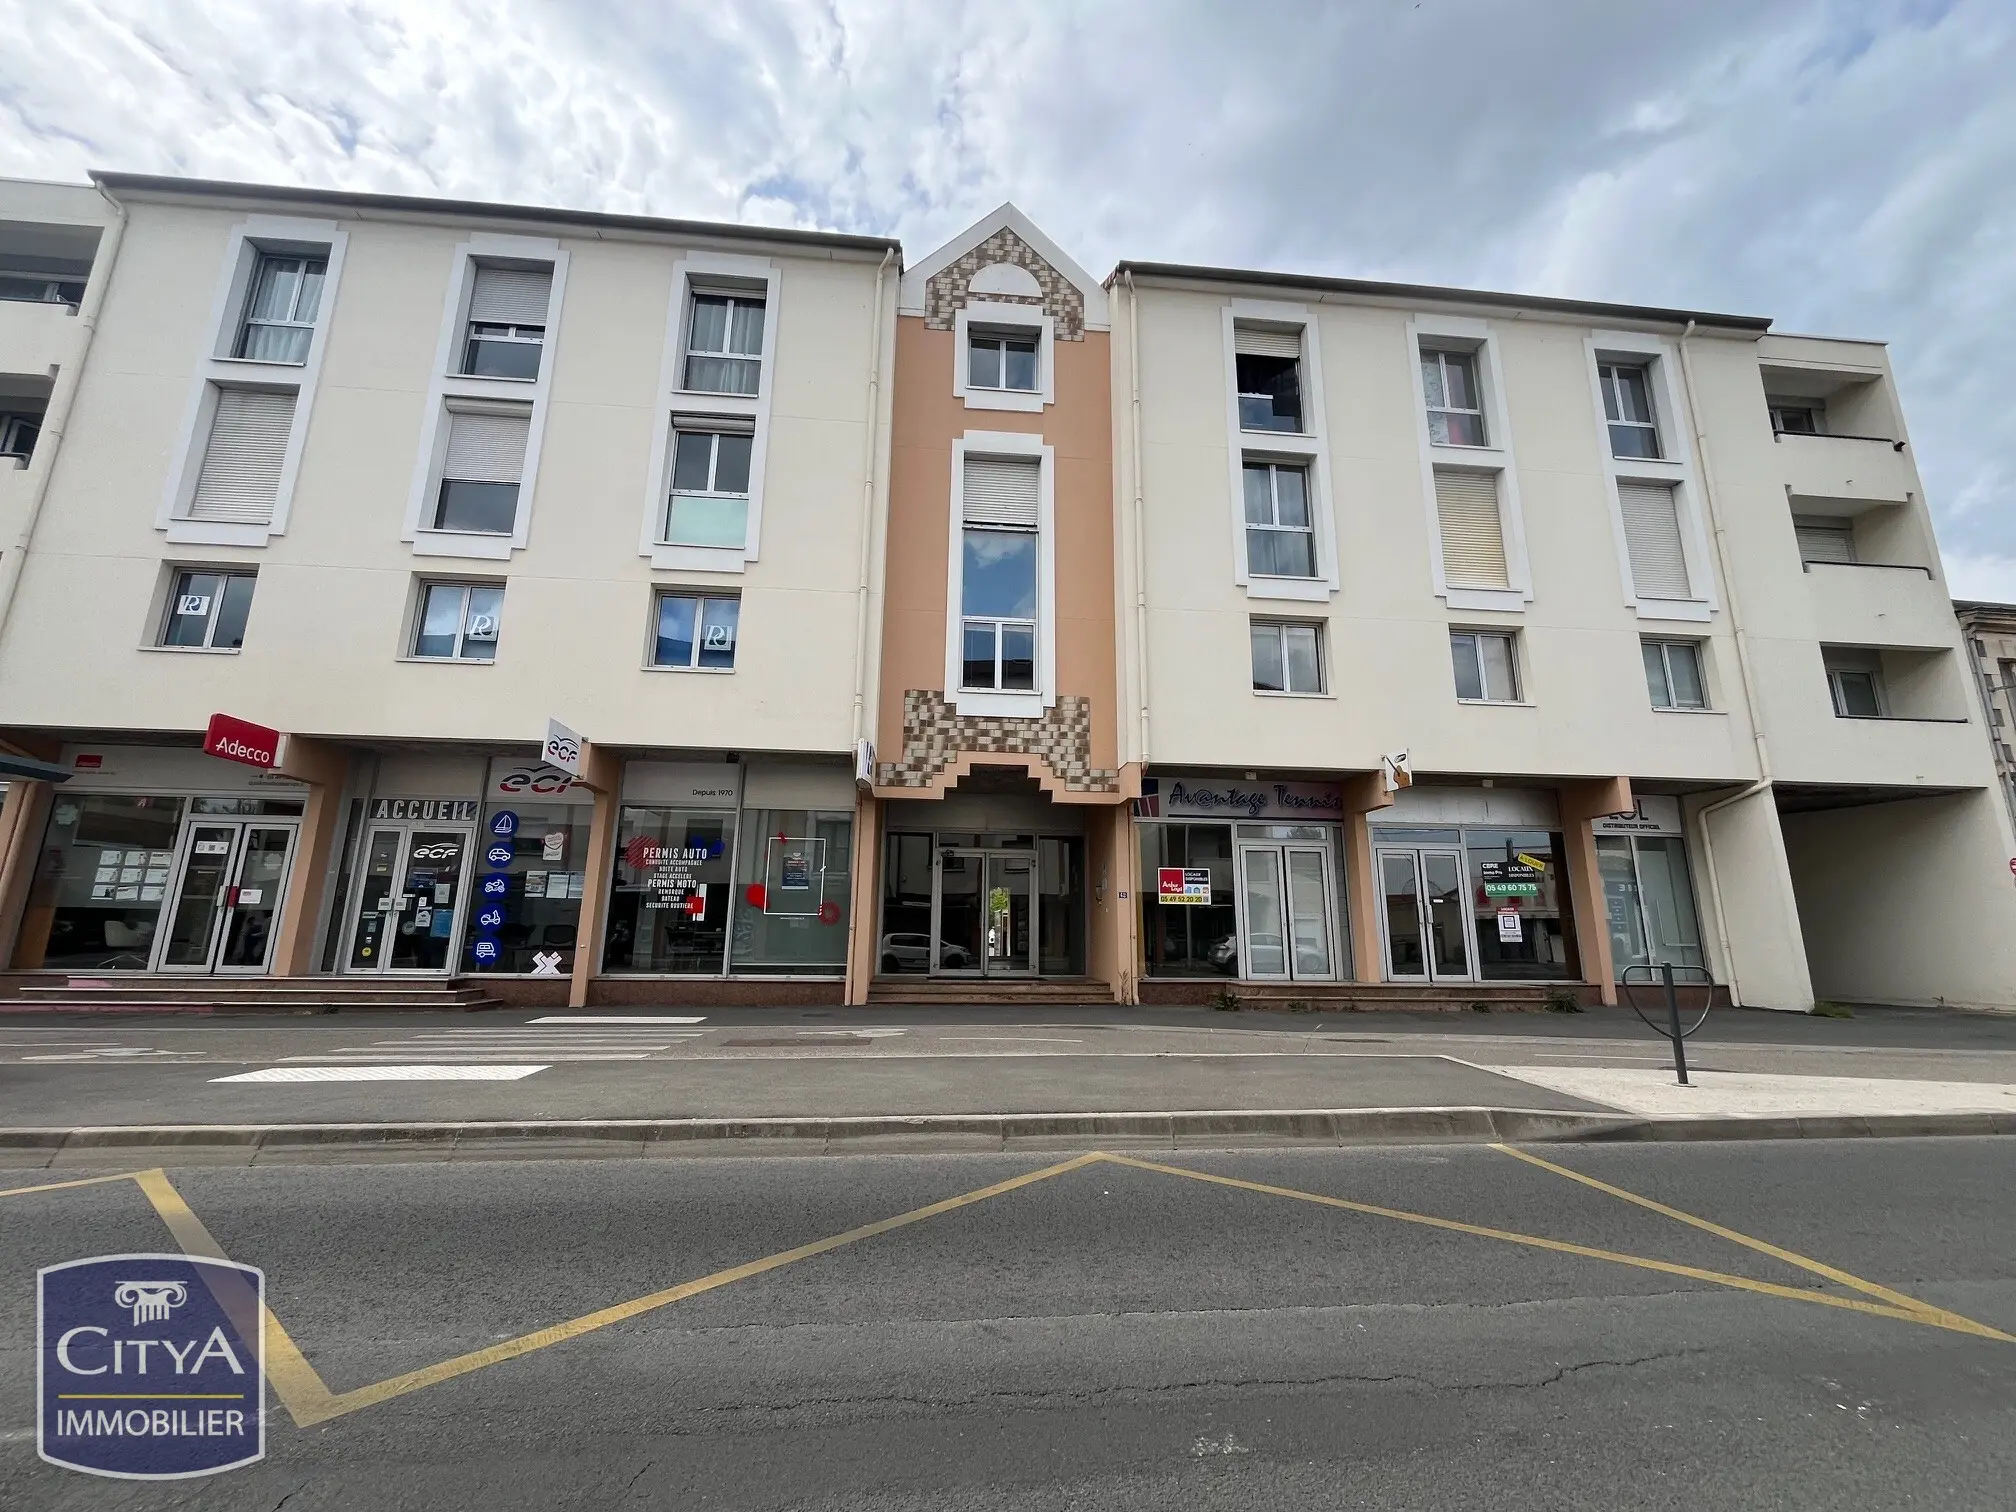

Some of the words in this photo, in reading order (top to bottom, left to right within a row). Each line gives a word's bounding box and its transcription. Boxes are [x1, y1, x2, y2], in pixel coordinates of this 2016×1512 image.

[215, 736, 270, 763] Adecco
[692, 789, 716, 797] Depuis
[718, 789, 734, 797] 1970
[1273, 784, 1342, 809] Tennis
[376, 799, 471, 820] ACCUEIL
[642, 847, 679, 859] PERMIS
[682, 848, 708, 860] AUTO
[647, 879, 675, 888] PERMIS
[676, 879, 697, 889] MOTO
[1486, 884, 1496, 892] 05
[1497, 884, 1507, 892] 49
[1528, 883, 1537, 891] 75
[1160, 895, 1169, 903] 05
[1169, 895, 1177, 903] 49
[1186, 895, 1194, 903] 20
[1195, 895, 1203, 903] 20
